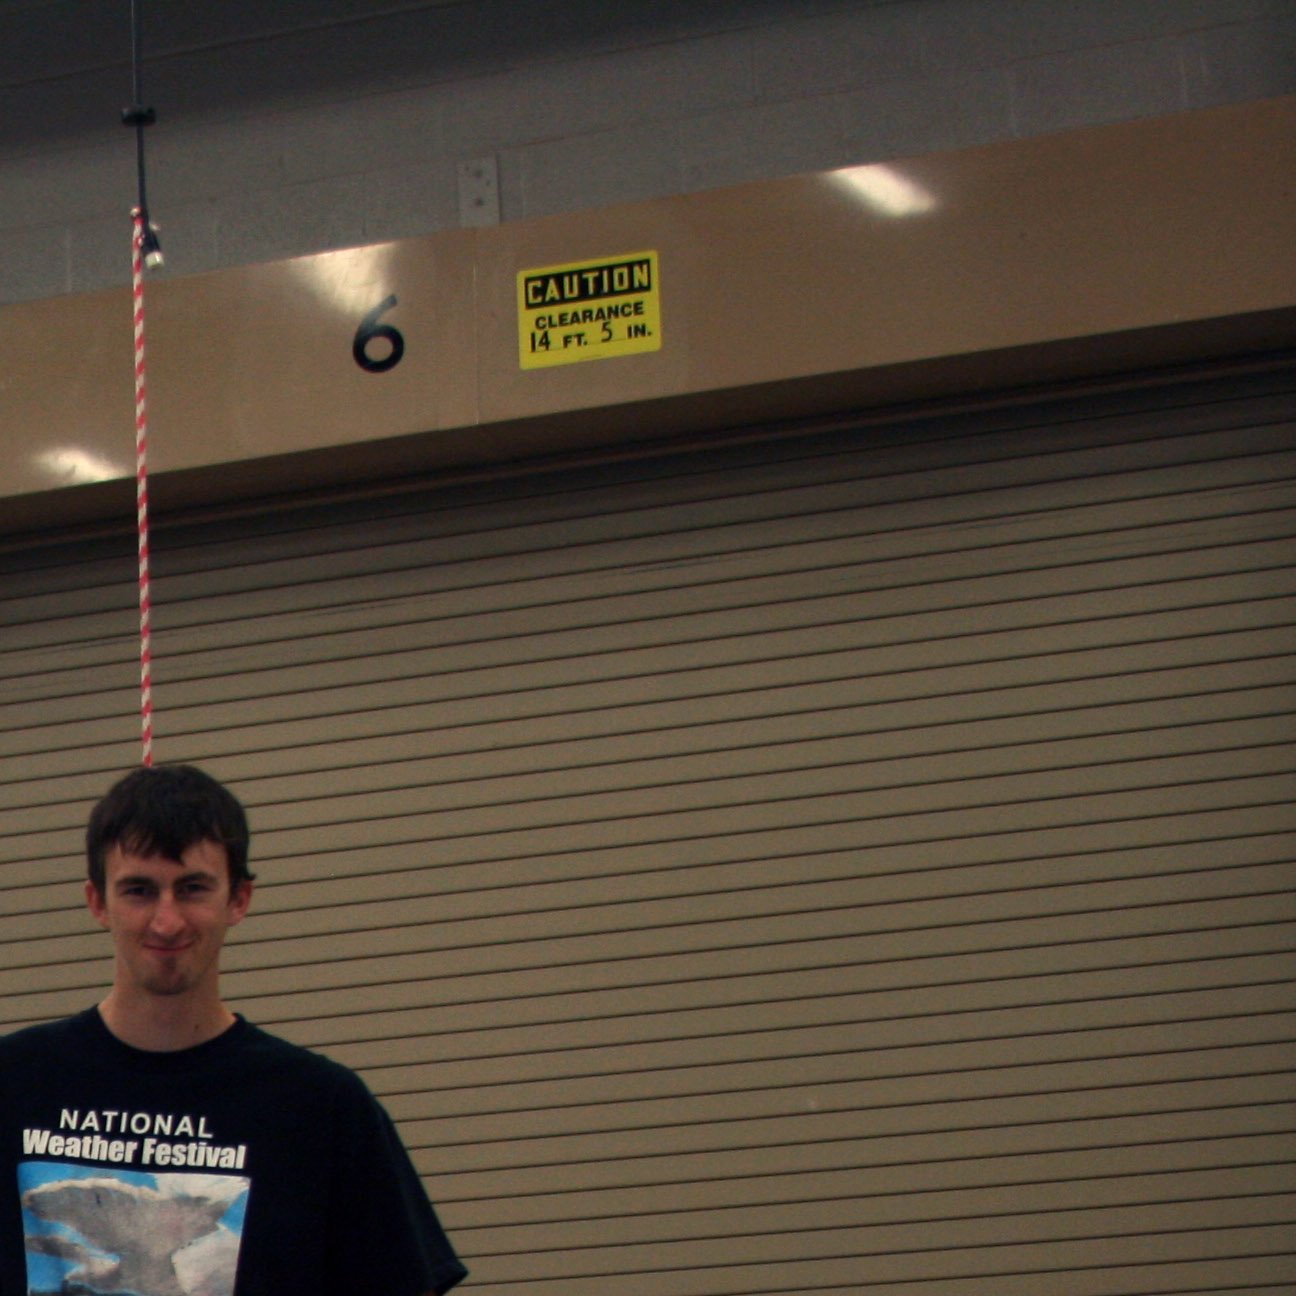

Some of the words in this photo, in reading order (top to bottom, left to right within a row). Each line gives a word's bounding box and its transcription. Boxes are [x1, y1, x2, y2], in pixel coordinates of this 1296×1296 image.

[526, 263, 650, 306] CAUTION
[352, 294, 406, 374] 6
[534, 301, 645, 330] CLEARANCE
[530, 331, 551, 353] 14
[562, 333, 588, 349] FT.
[600, 321, 613, 343] 5
[627, 323, 652, 339] IN.
[59, 1108, 214, 1139] NATIONAL
[22, 1128, 138, 1163] Weather
[141, 1137, 247, 1170] Festival
